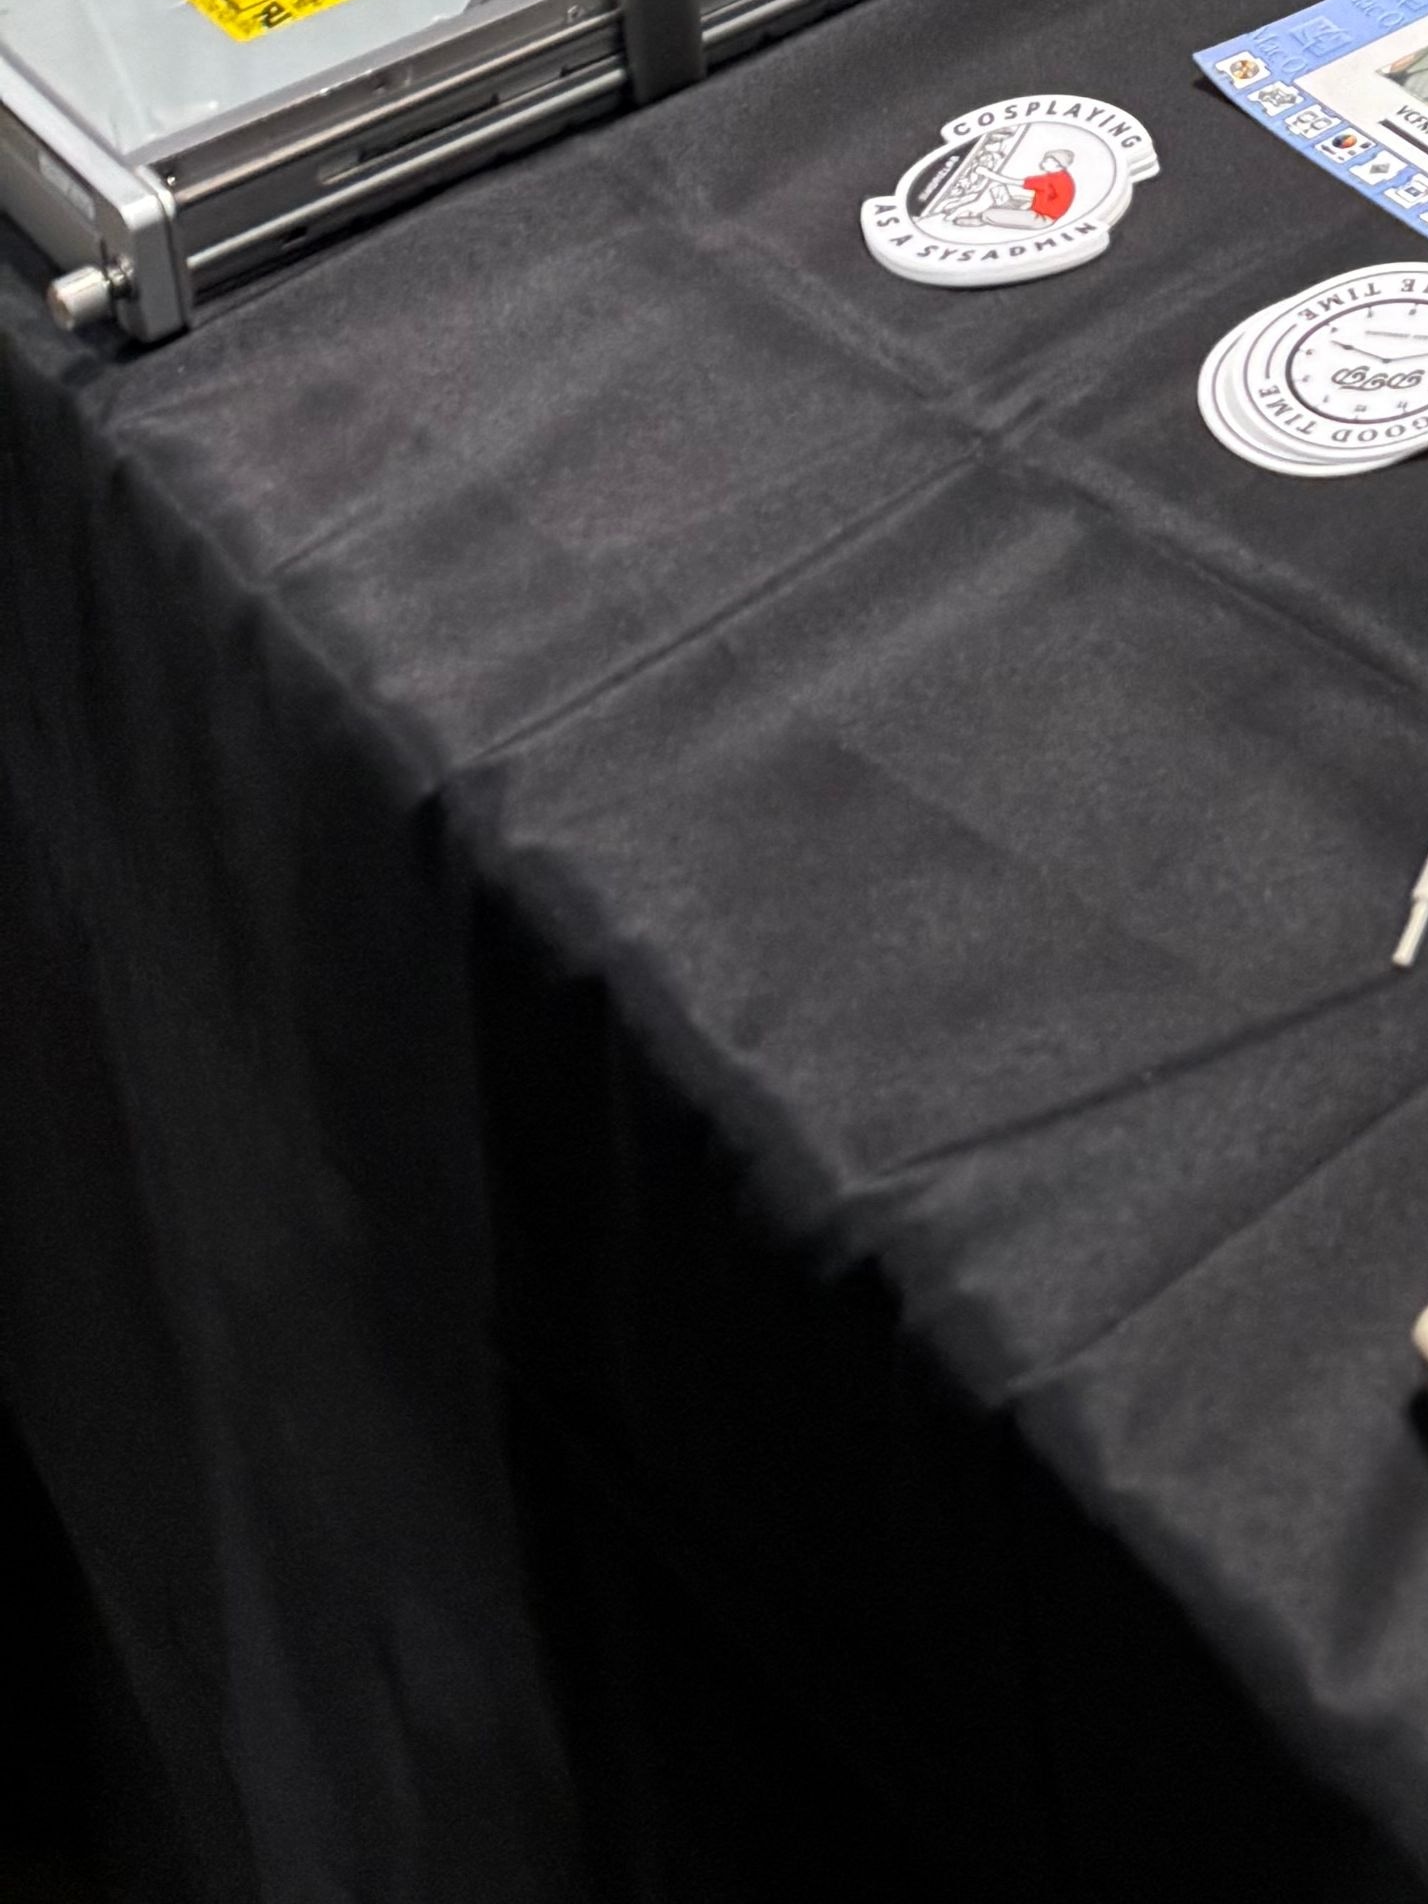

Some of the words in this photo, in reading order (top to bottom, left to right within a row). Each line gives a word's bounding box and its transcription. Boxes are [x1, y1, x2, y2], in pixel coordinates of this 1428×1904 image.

[953, 100, 1142, 150] COSPLAYING
[875, 203, 900, 228] AS
[890, 234, 913, 246] A
[917, 223, 1098, 261] SYSADMIN
[1298, 282, 1382, 321] TIME
[1259, 384, 1318, 436] TIME
